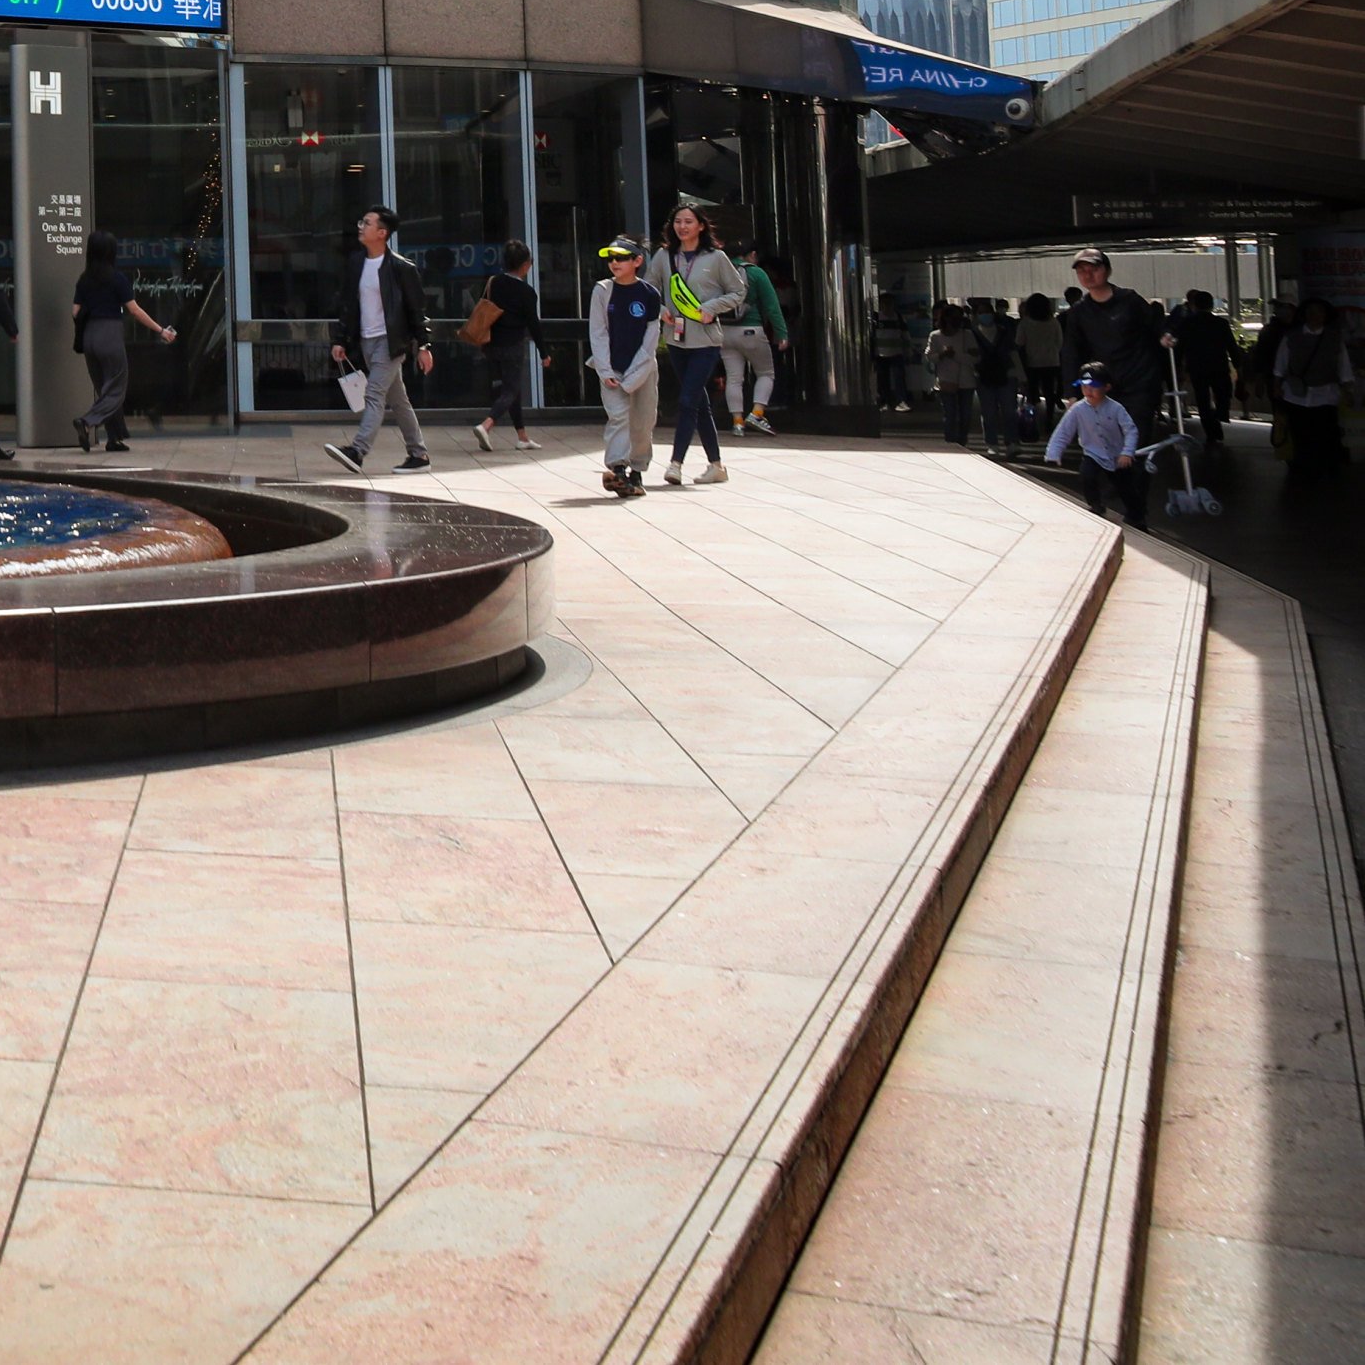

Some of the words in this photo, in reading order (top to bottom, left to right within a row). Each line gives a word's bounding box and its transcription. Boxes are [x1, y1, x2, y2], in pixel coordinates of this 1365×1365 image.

[42, 222, 58, 232] One
[59, 222, 66, 232] &
[66, 222, 82, 233] Two
[46, 233, 82, 245] Exchange
[56, 244, 82, 255] Square
